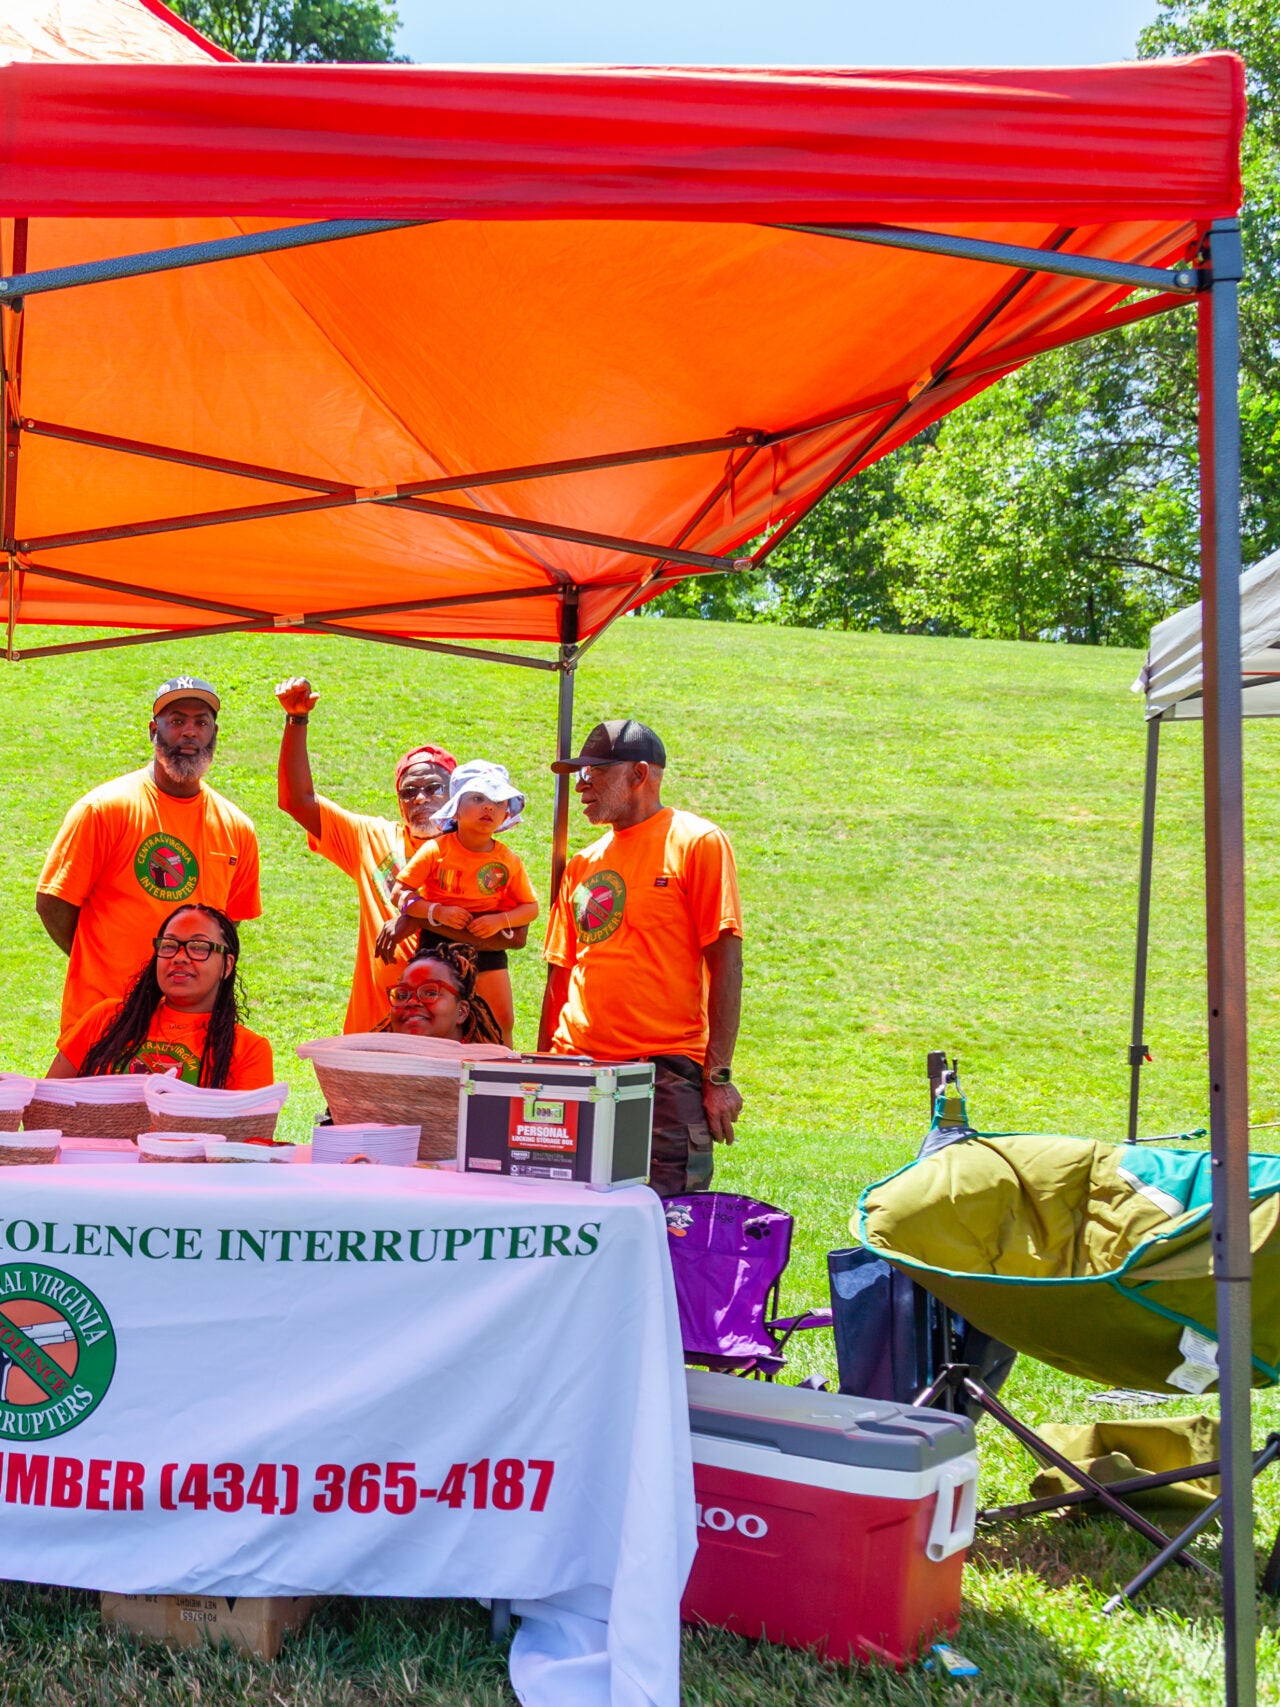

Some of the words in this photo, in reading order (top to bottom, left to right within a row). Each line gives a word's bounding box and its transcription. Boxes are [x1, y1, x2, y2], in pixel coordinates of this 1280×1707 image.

[137, 835, 165, 864] CENTRAL
[164, 836, 192, 865] VIRGINIA
[140, 876, 197, 900] INTERRUPTERS
[516, 1125, 570, 1139] PERSONAL
[216, 1221, 603, 1263] INTERRUPTERS
[30, 1271, 108, 1348] VIRGINIA
[159, 1462, 300, 1516] (434)
[313, 1459, 556, 1516] 365-4187
